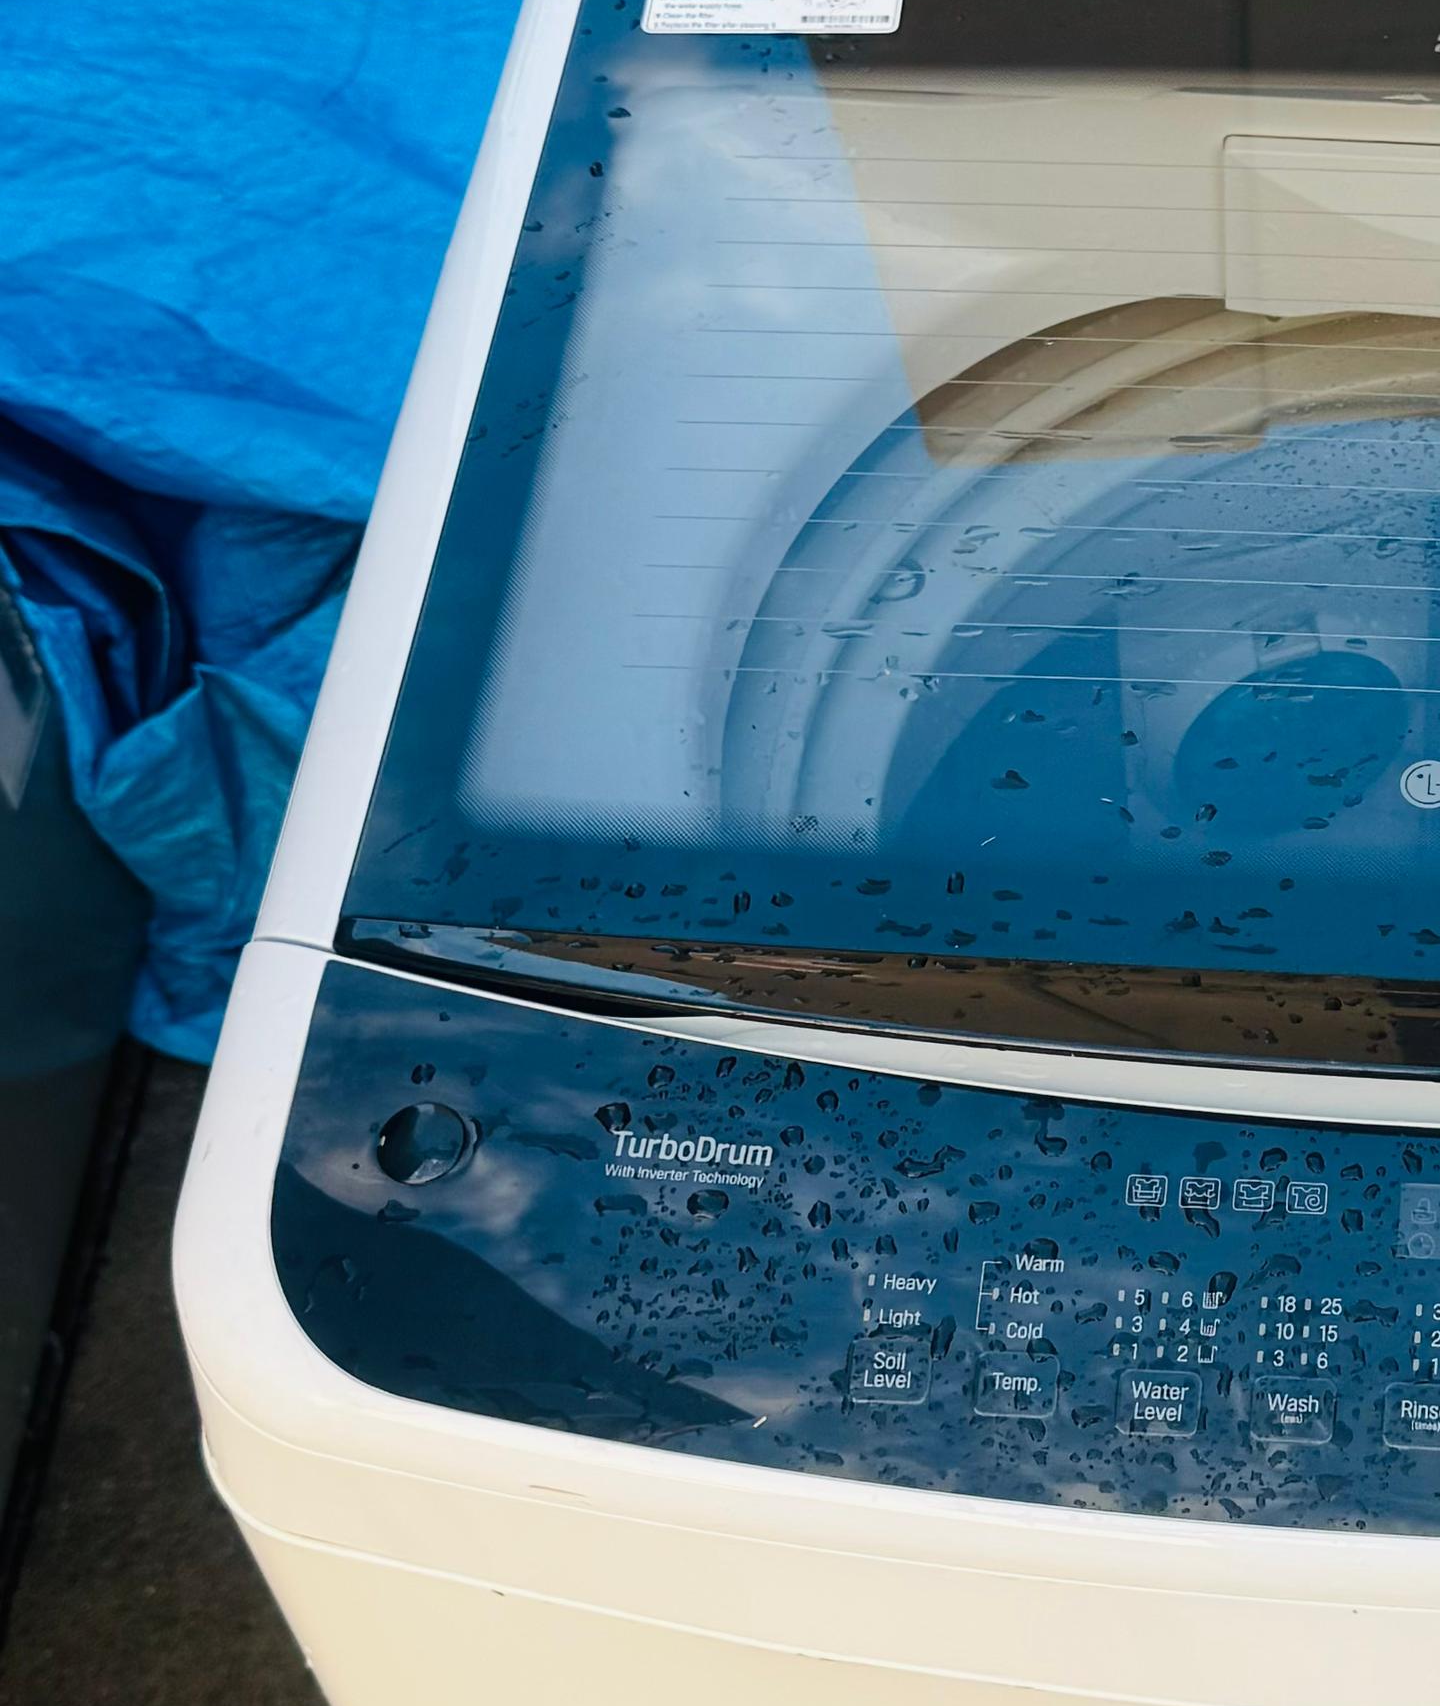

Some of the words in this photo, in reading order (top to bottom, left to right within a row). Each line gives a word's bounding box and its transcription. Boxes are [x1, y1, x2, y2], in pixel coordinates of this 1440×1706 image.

[611, 1131, 773, 1167] TurboDrum
[604, 1163, 635, 1179] With
[637, 1166, 690, 1182] Inverter
[692, 1169, 765, 1188] Technology
[1015, 1253, 1065, 1273] Warm
[883, 1273, 937, 1294] Heavy
[1009, 1287, 1040, 1305] Hot
[1134, 1289, 1145, 1305] 5
[1182, 1291, 1193, 1308] 6
[1277, 1296, 1297, 1312] 18
[1320, 1298, 1343, 1316] 25
[878, 1308, 921, 1328] Light
[1131, 1316, 1143, 1332] 3
[1179, 1318, 1191, 1334] 4
[1006, 1322, 1043, 1340] Cold
[1275, 1323, 1295, 1340] 10
[1320, 1325, 1338, 1342] 15
[873, 1351, 907, 1371] Soil
[1131, 1343, 1138, 1360] 1
[1177, 1346, 1188, 1362] 2
[1273, 1350, 1285, 1367] 3
[1316, 1353, 1328, 1370] 6
[1431, 1358, 1439, 1375] 1
[863, 1370, 911, 1389] Level
[992, 1372, 1043, 1395] Temp.
[1131, 1380, 1190, 1401] Water
[1133, 1402, 1183, 1422] Level
[1267, 1393, 1320, 1413] Wash
